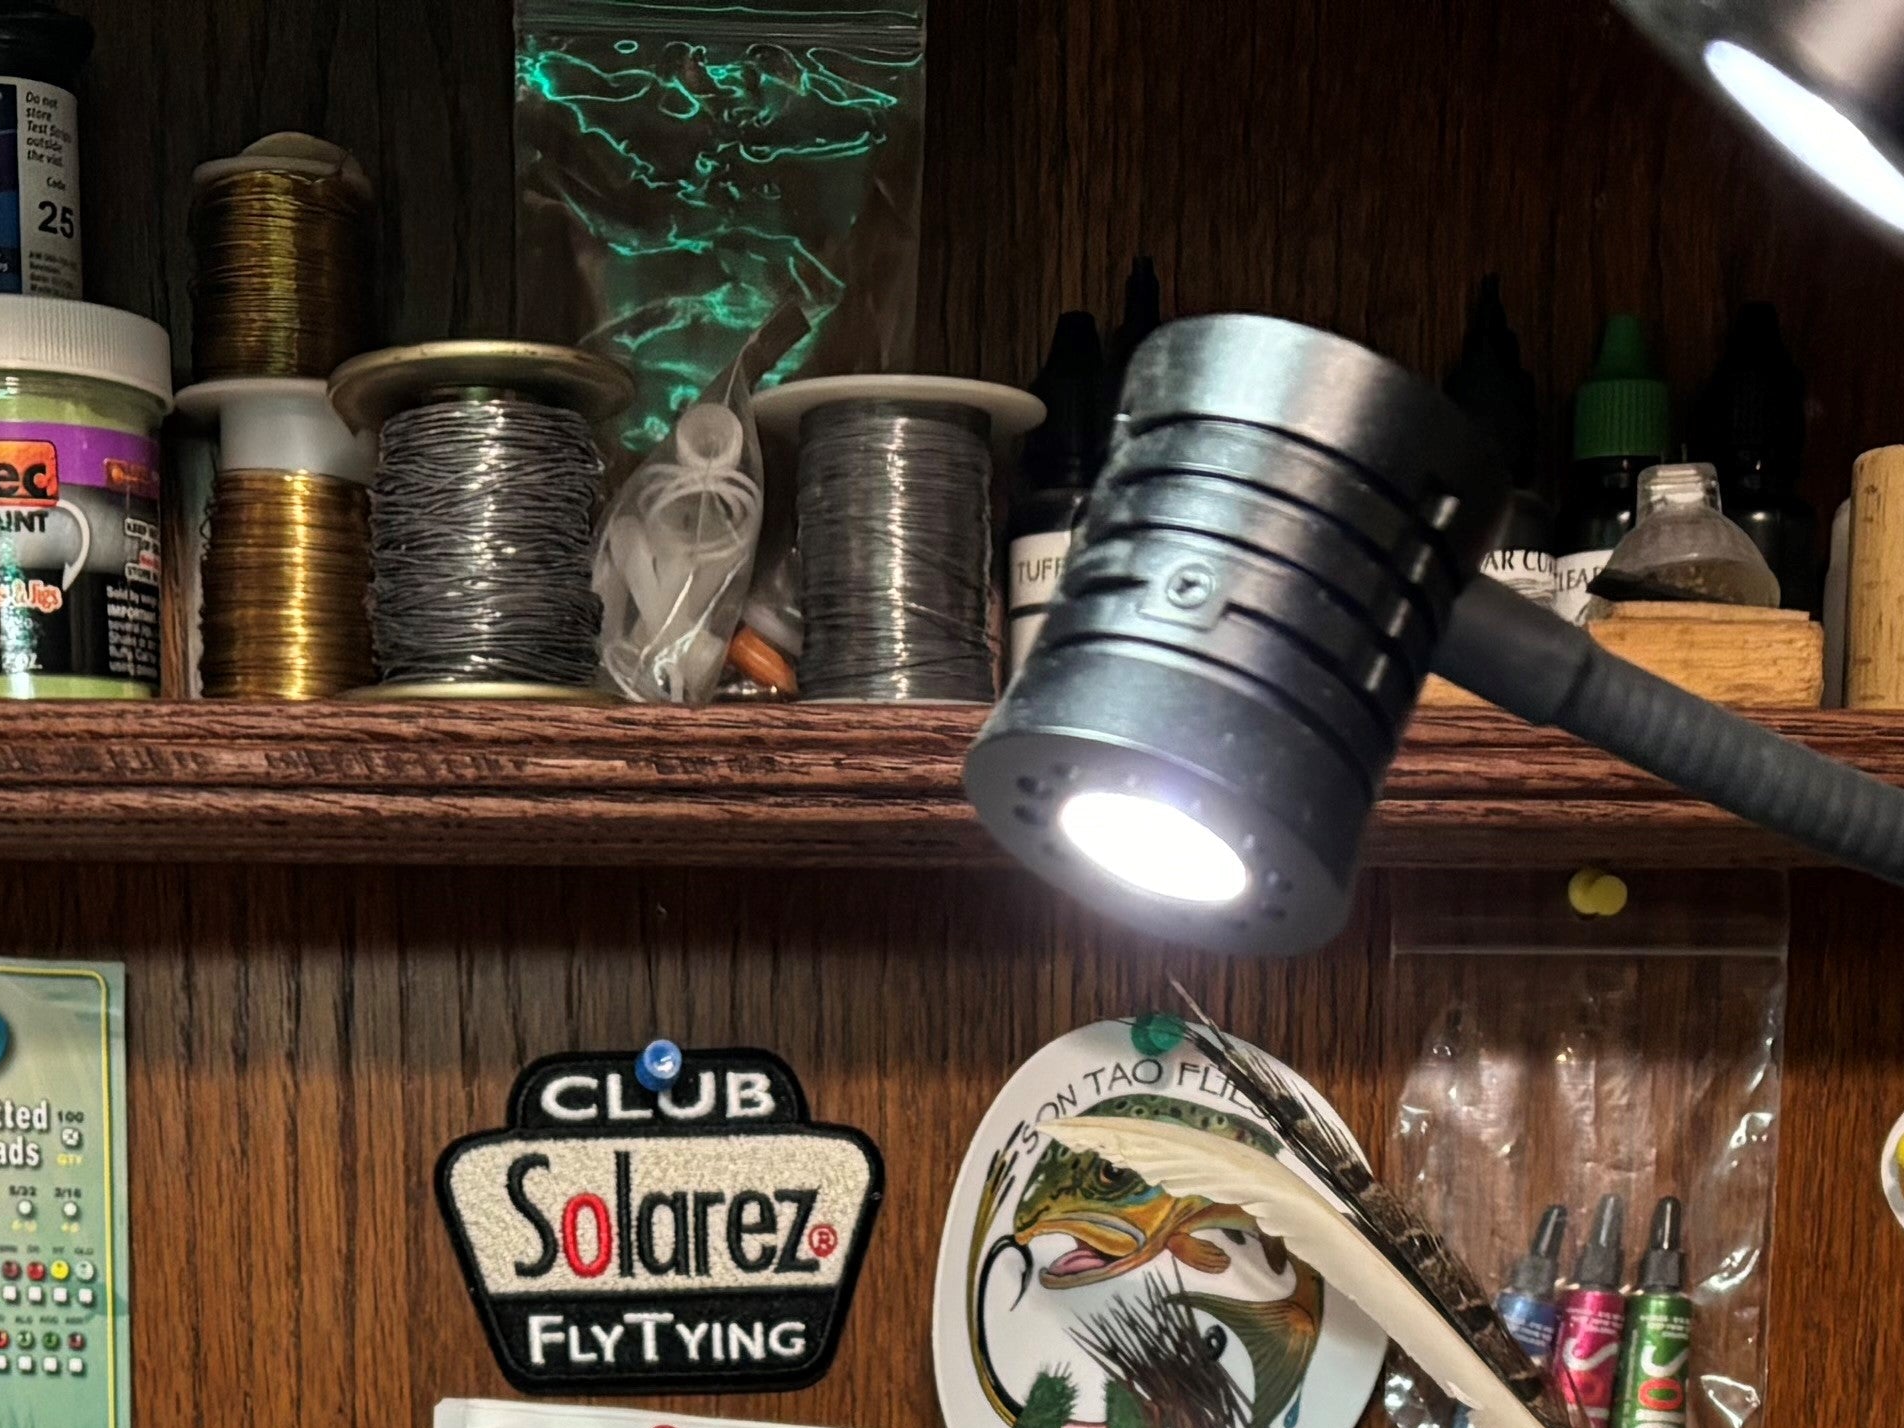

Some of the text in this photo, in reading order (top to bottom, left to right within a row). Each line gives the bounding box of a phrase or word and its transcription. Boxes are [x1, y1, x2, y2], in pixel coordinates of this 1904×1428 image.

[38, 201, 74, 239] 25
[540, 1071, 776, 1121] CLUB
[1083, 1058, 1163, 1096] TAO
[57, 1111, 84, 1123] 100
[506, 1151, 821, 1279] Solarez
